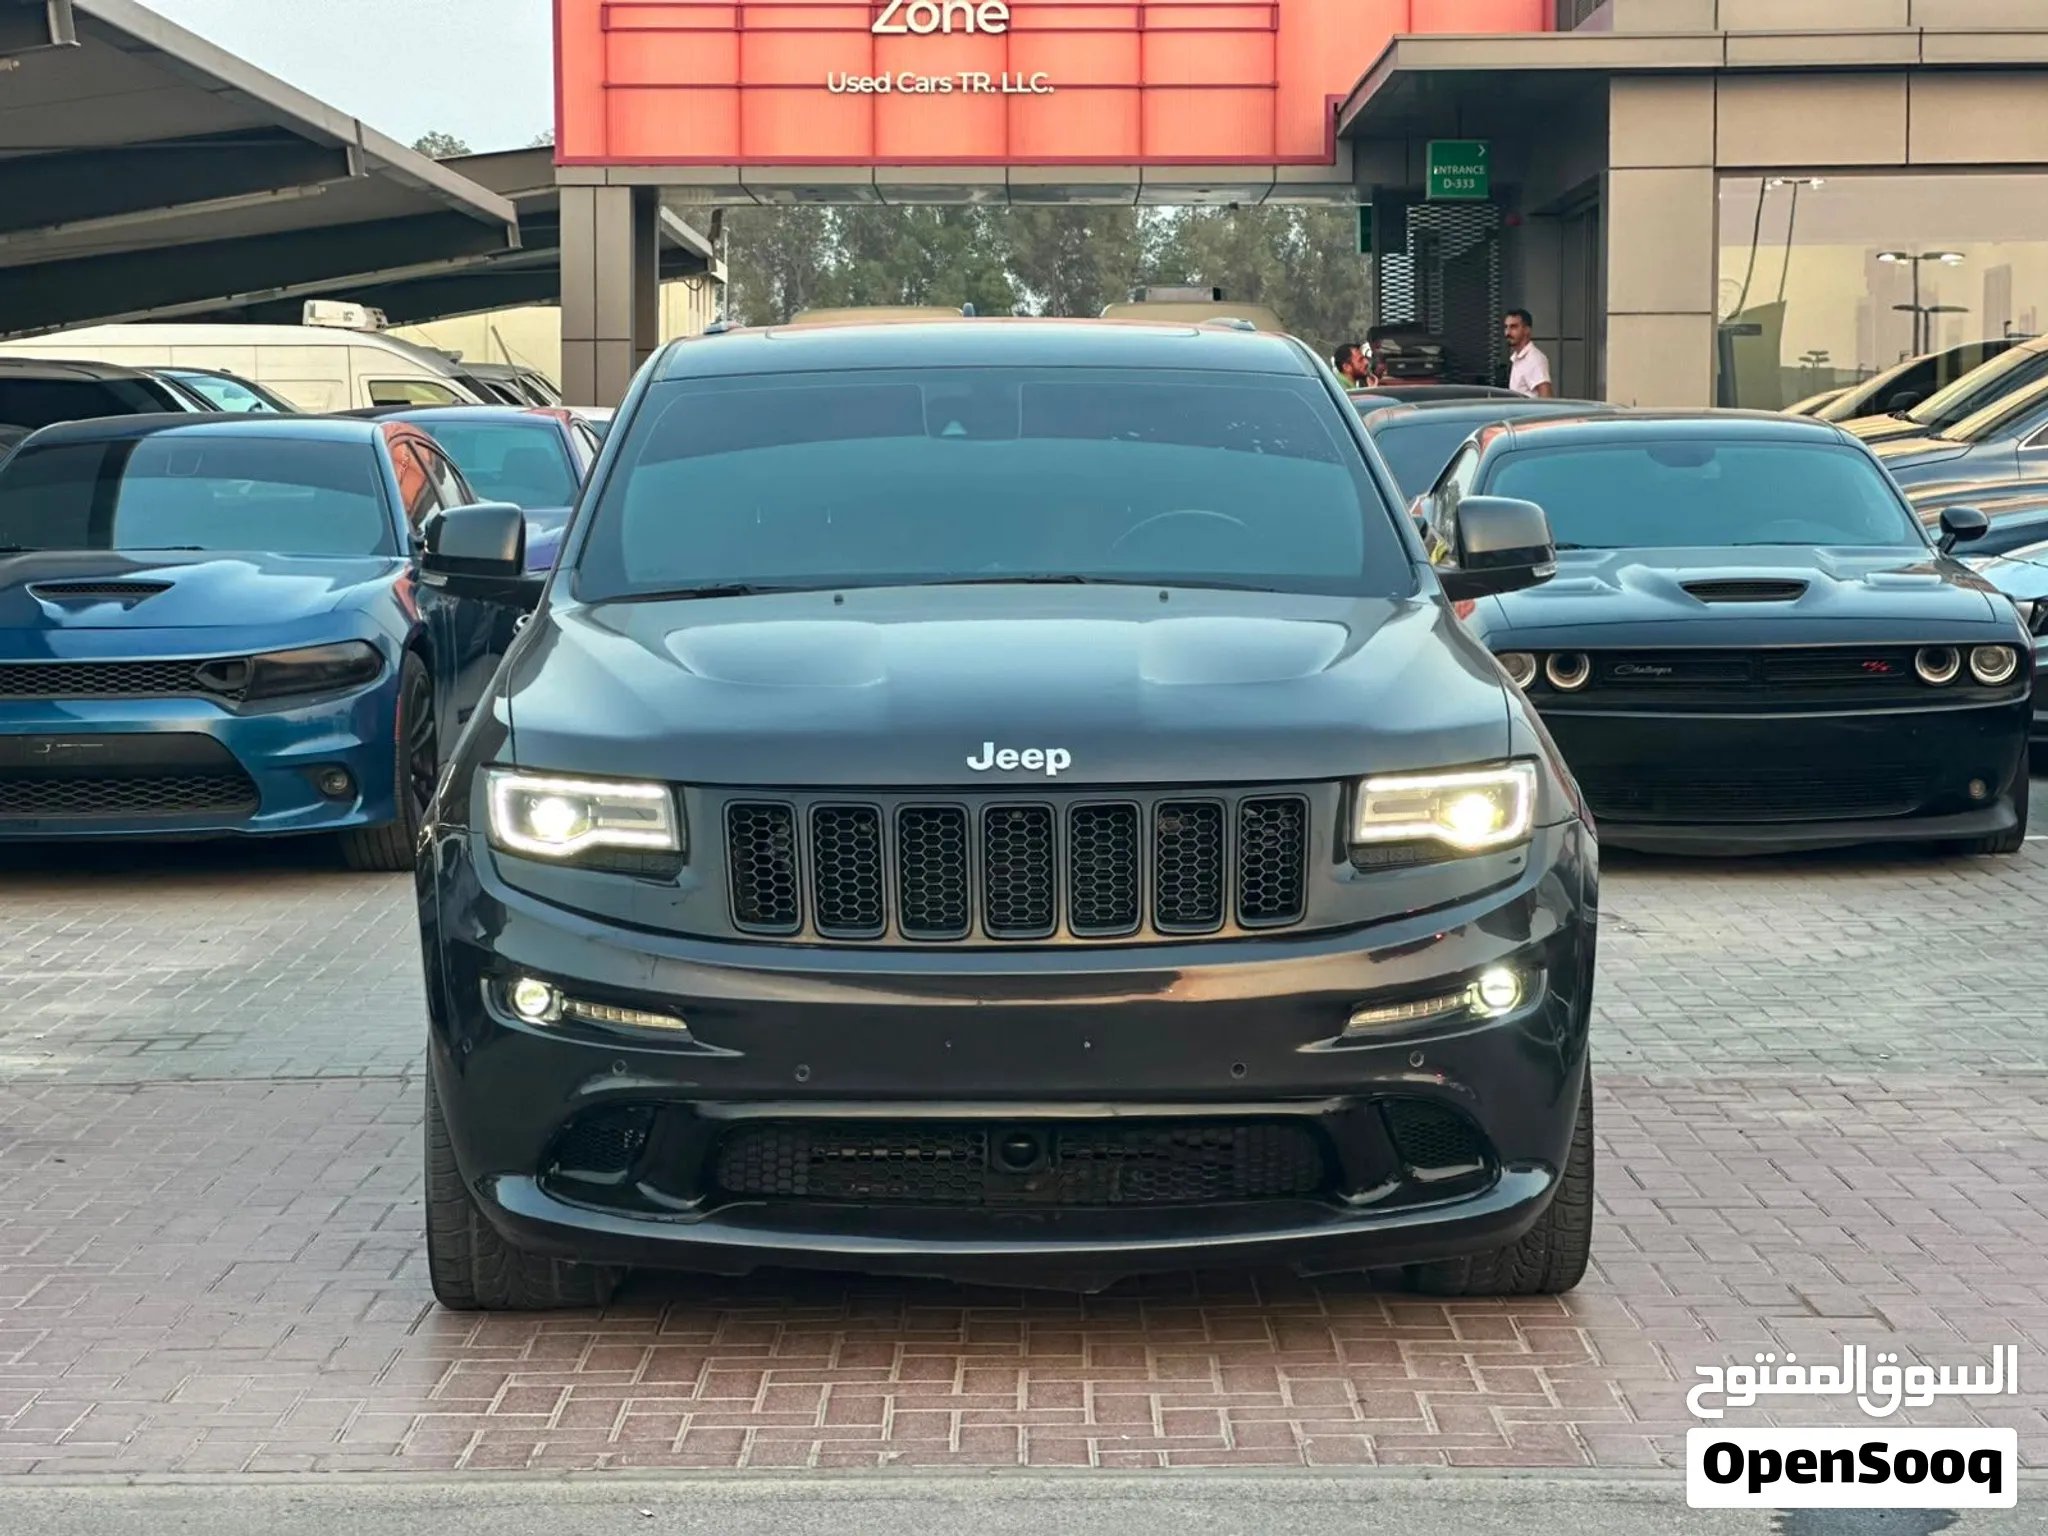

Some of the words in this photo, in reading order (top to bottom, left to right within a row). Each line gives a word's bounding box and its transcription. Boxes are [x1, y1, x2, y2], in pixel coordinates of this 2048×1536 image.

[871, 0, 1010, 34] Zone
[827, 71, 891, 94] Used
[896, 71, 953, 94] Cars
[956, 72, 996, 93] TR.
[1002, 71, 1055, 94] LLC.
[1433, 165, 1485, 175] ENTRANCE
[1443, 178, 1475, 189] D-333
[966, 741, 1072, 776] Jeep
